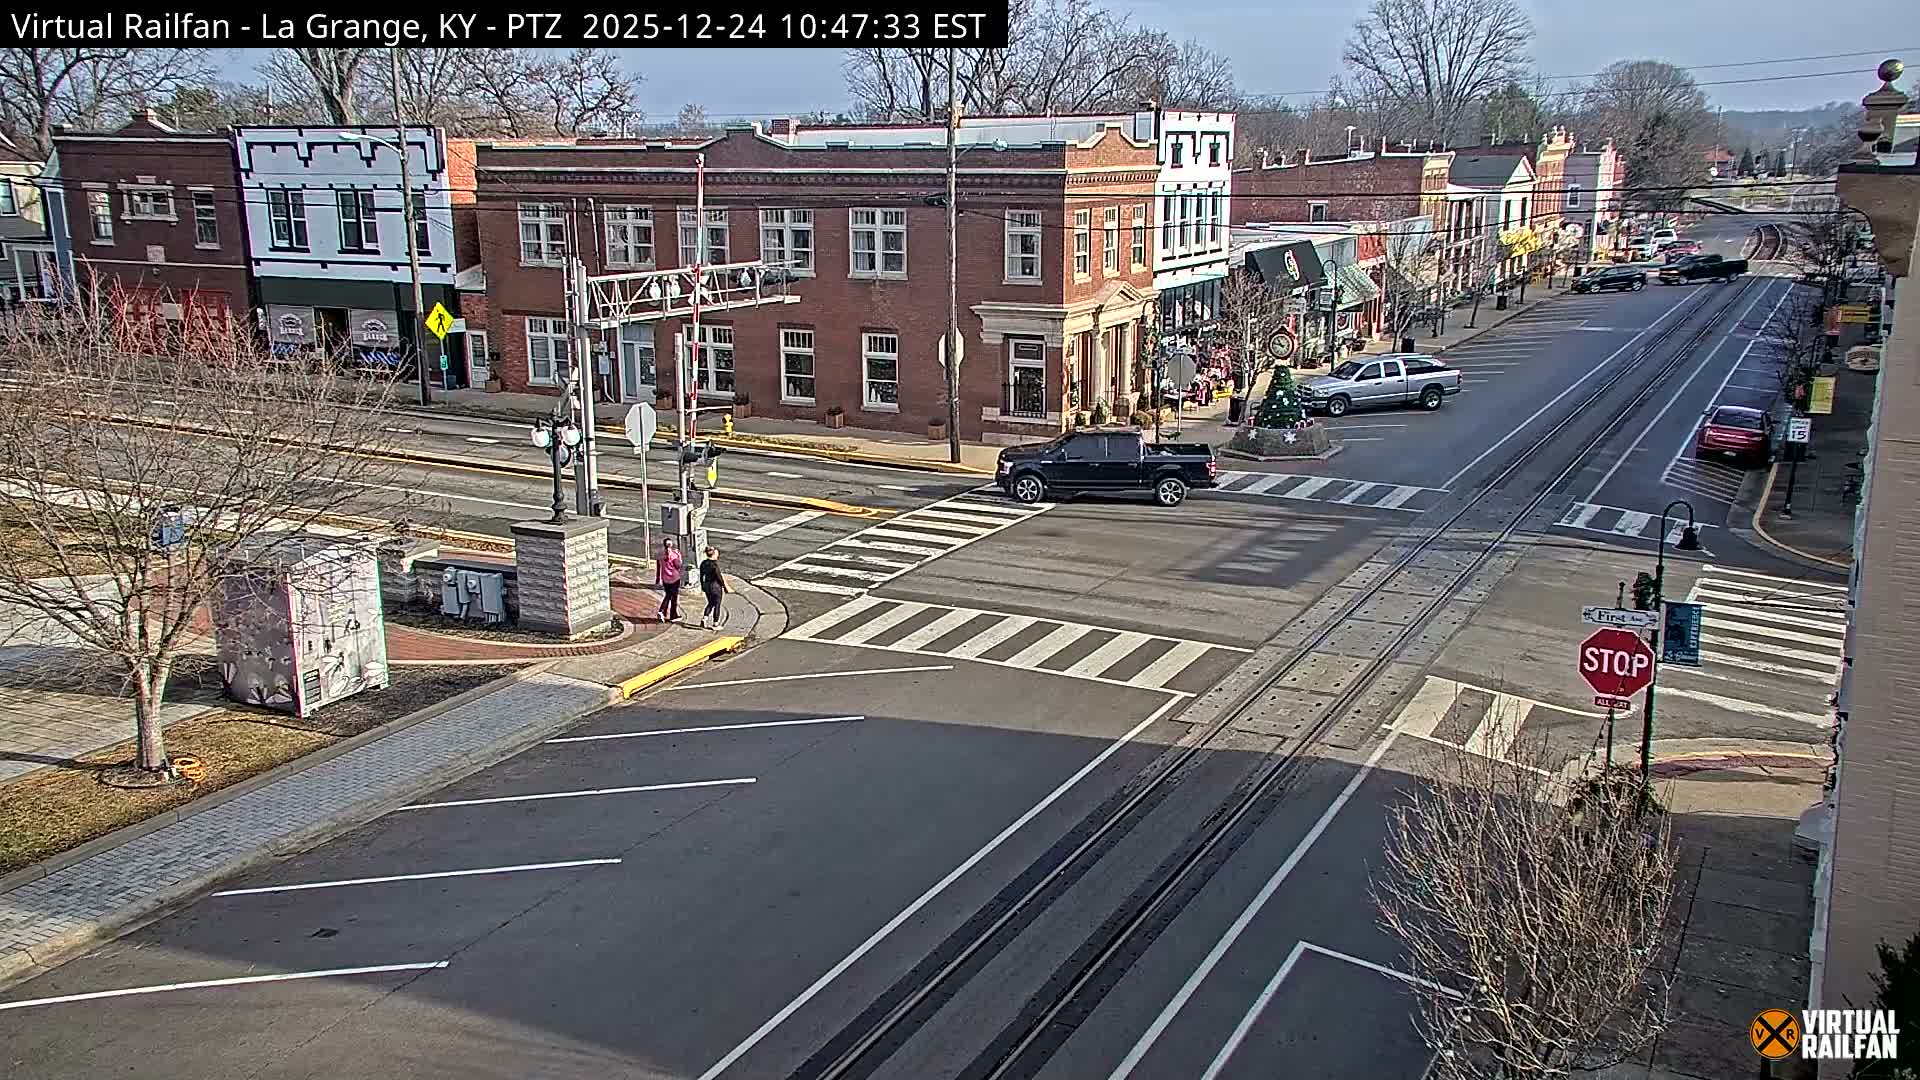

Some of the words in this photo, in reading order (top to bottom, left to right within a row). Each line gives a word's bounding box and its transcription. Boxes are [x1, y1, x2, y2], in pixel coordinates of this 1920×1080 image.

[1791, 430, 1807, 440] 15
[1598, 610, 1626, 622] First
[1583, 646, 1649, 678] STOP
